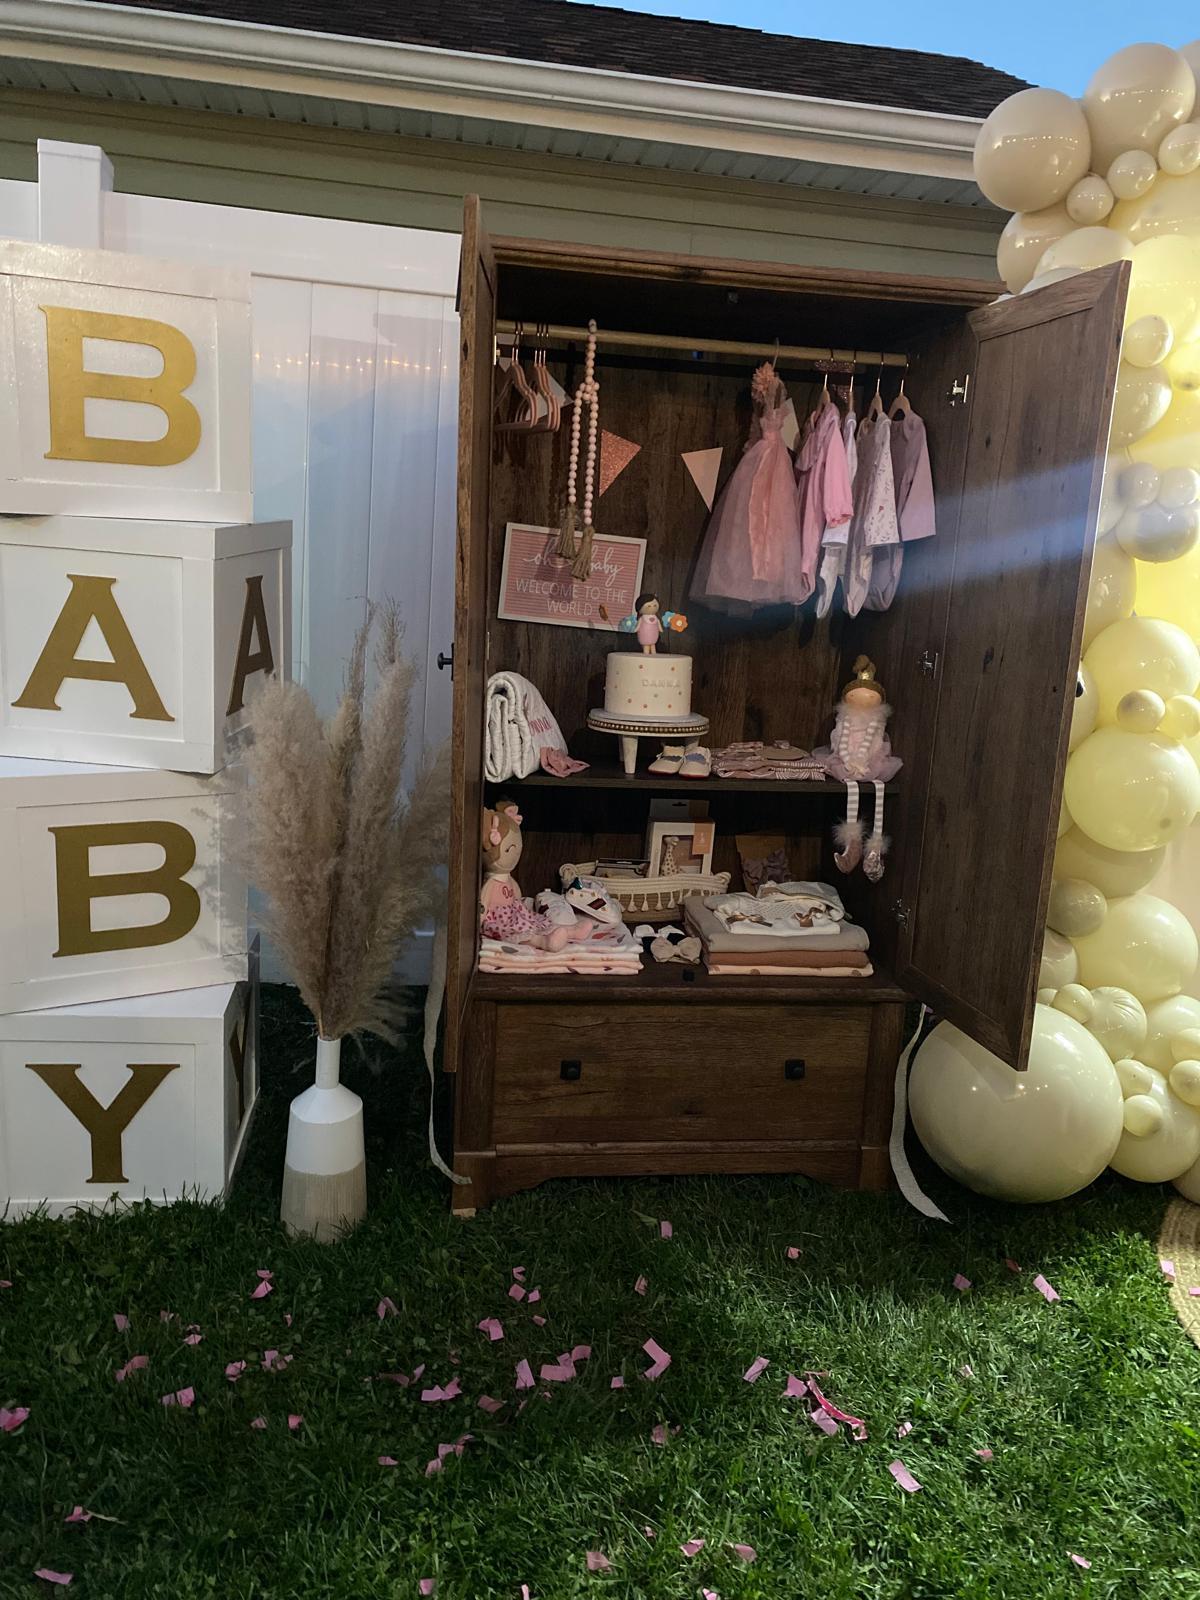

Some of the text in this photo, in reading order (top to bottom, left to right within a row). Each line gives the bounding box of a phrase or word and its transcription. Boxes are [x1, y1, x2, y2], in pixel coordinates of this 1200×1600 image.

[38, 304, 202, 467] B
[11, 573, 175, 722] A
[226, 575, 276, 717] A
[516, 579, 628, 604] WELCOME TO THE
[547, 600, 593, 616] WORLD
[48, 820, 202, 959] B
[25, 1063, 180, 1183] Y
